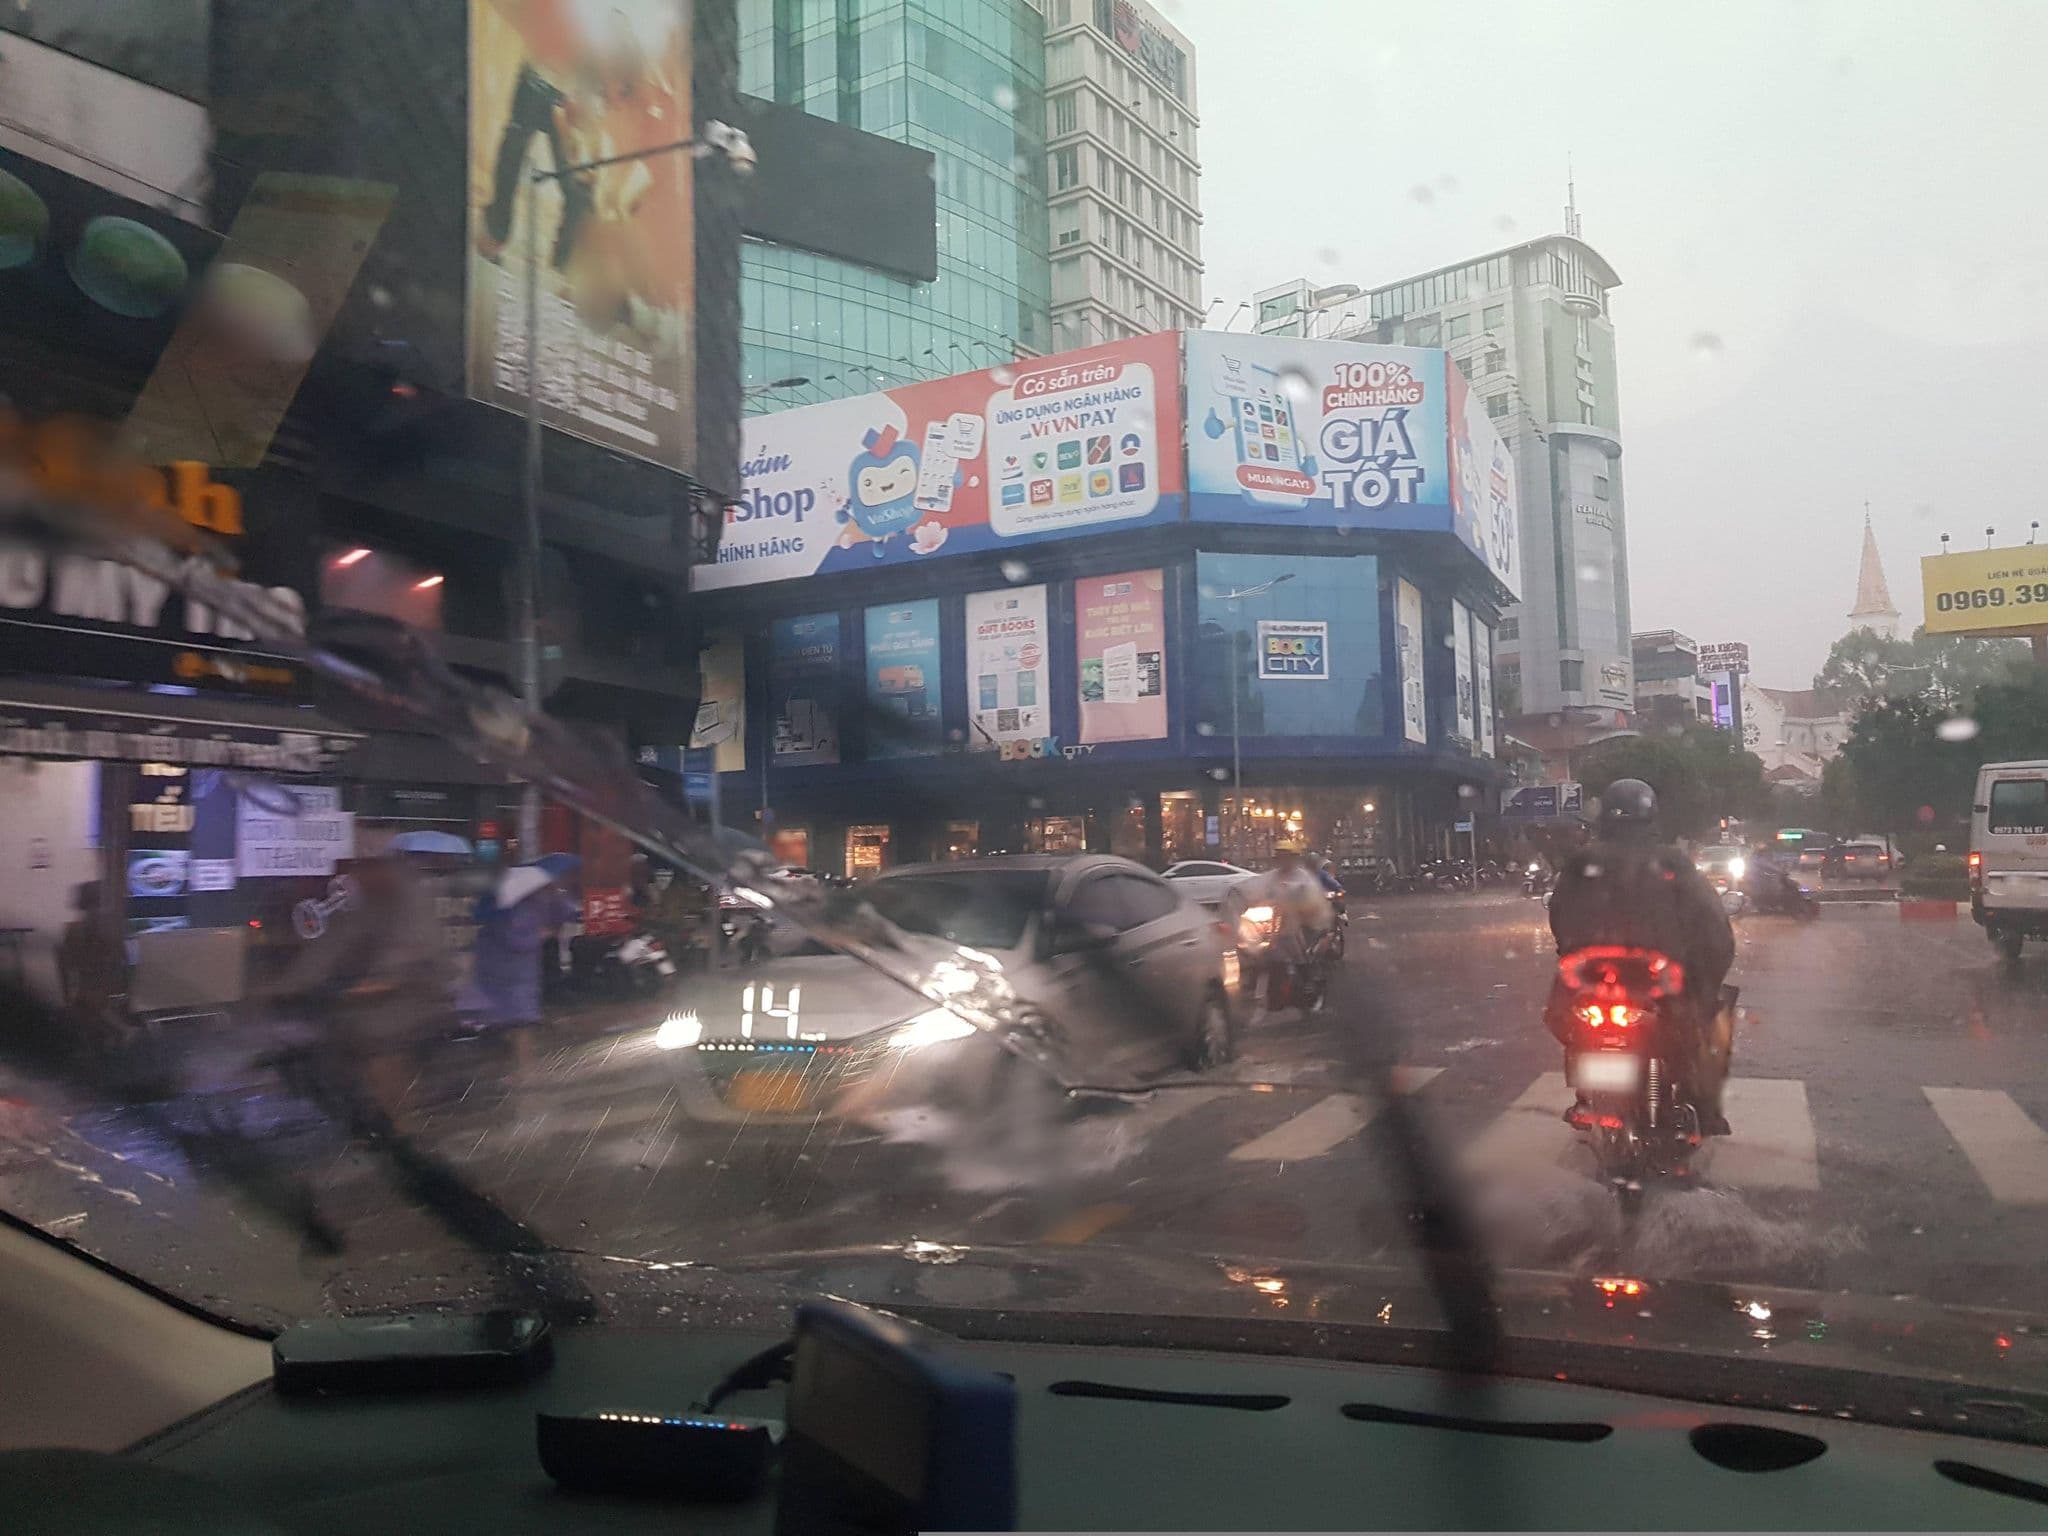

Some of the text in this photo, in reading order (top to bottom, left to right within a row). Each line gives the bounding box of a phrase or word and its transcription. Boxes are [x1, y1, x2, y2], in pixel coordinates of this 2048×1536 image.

[1022, 376, 1046, 396] Có
[1082, 364, 1115, 384] trên
[1335, 362, 1413, 388] 100%
[1326, 388, 1375, 407] CHÍNH
[1052, 408, 1117, 434] VNPAY
[1321, 407, 1417, 464] GIÁ
[1247, 472, 1273, 486] MUA
[1323, 456, 1425, 510] TỐT
[727, 486, 816, 524] Shop
[717, 544, 755, 564] HÍNH
[1000, 619, 1036, 633] BOOKS
[1267, 637, 1321, 655] BOOK
[1268, 656, 1320, 671] CITY
[1000, 736, 1062, 761] BOOK
[741, 986, 801, 1040] 14
